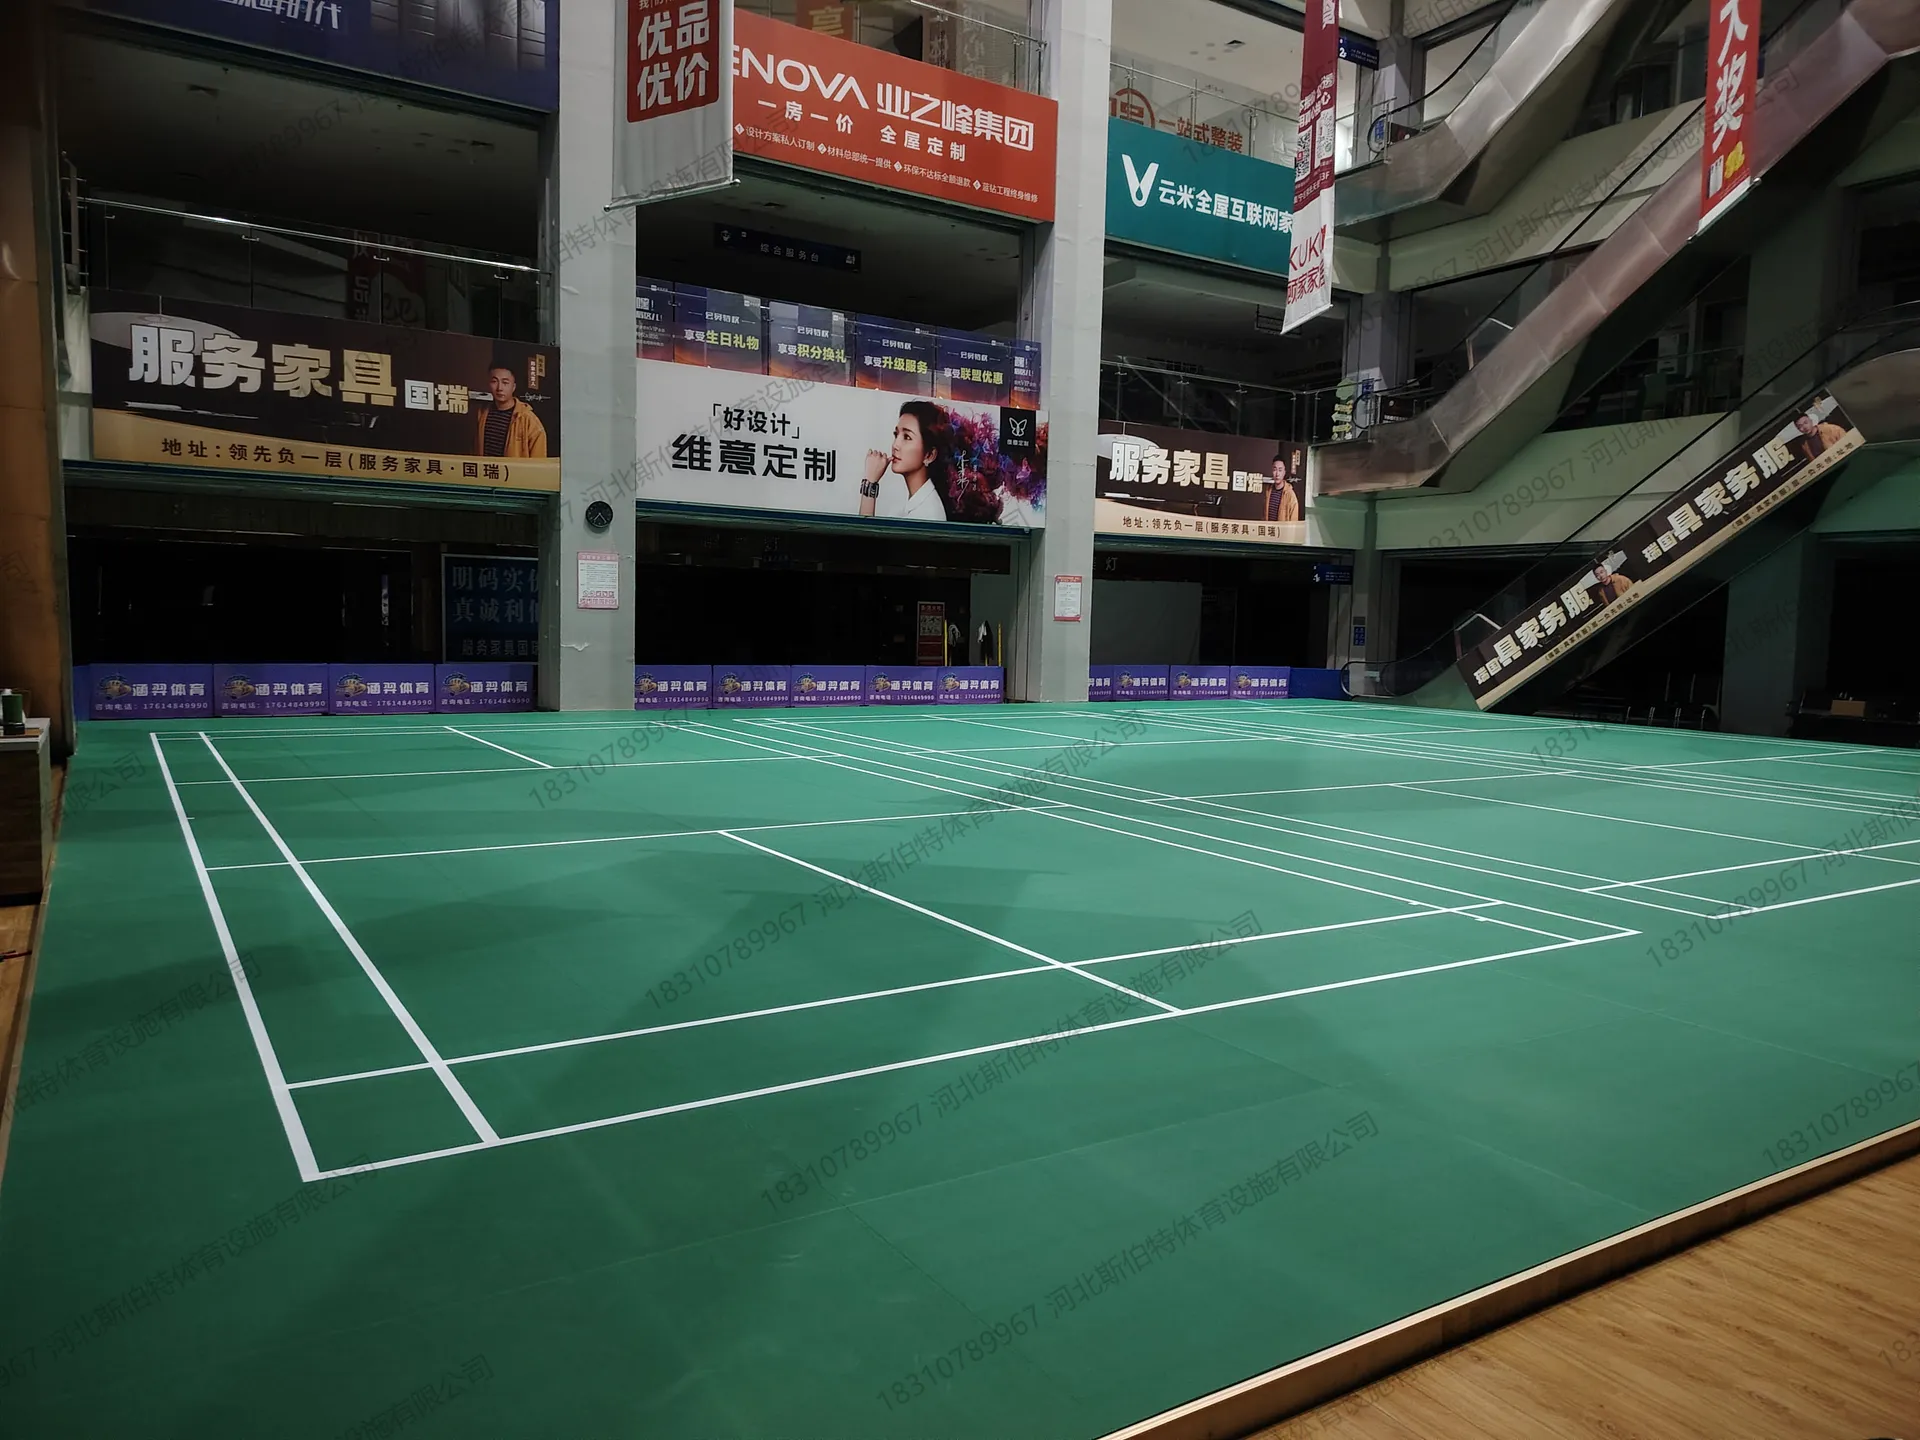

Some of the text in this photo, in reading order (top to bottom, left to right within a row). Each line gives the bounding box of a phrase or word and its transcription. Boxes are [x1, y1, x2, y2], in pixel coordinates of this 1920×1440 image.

[637, 0, 709, 61] 优品
[637, 52, 710, 111] 优价
[758, 99, 967, 162] 一房一价 全屋定制
[877, 82, 1034, 151] 业之峰集团
[760, 242, 820, 263] 综合服务台
[684, 329, 760, 351] 享受生日礼物
[778, 343, 847, 364] 享受积分换礼
[864, 355, 929, 375] 享受升级服务
[129, 323, 397, 407] 服务家具
[404, 378, 470, 416] 国瑞
[943, 366, 1004, 386] 享受联盟优惠
[672, 434, 837, 482] 维意定制
[1109, 442, 1264, 494] 服务家具 国瑞
